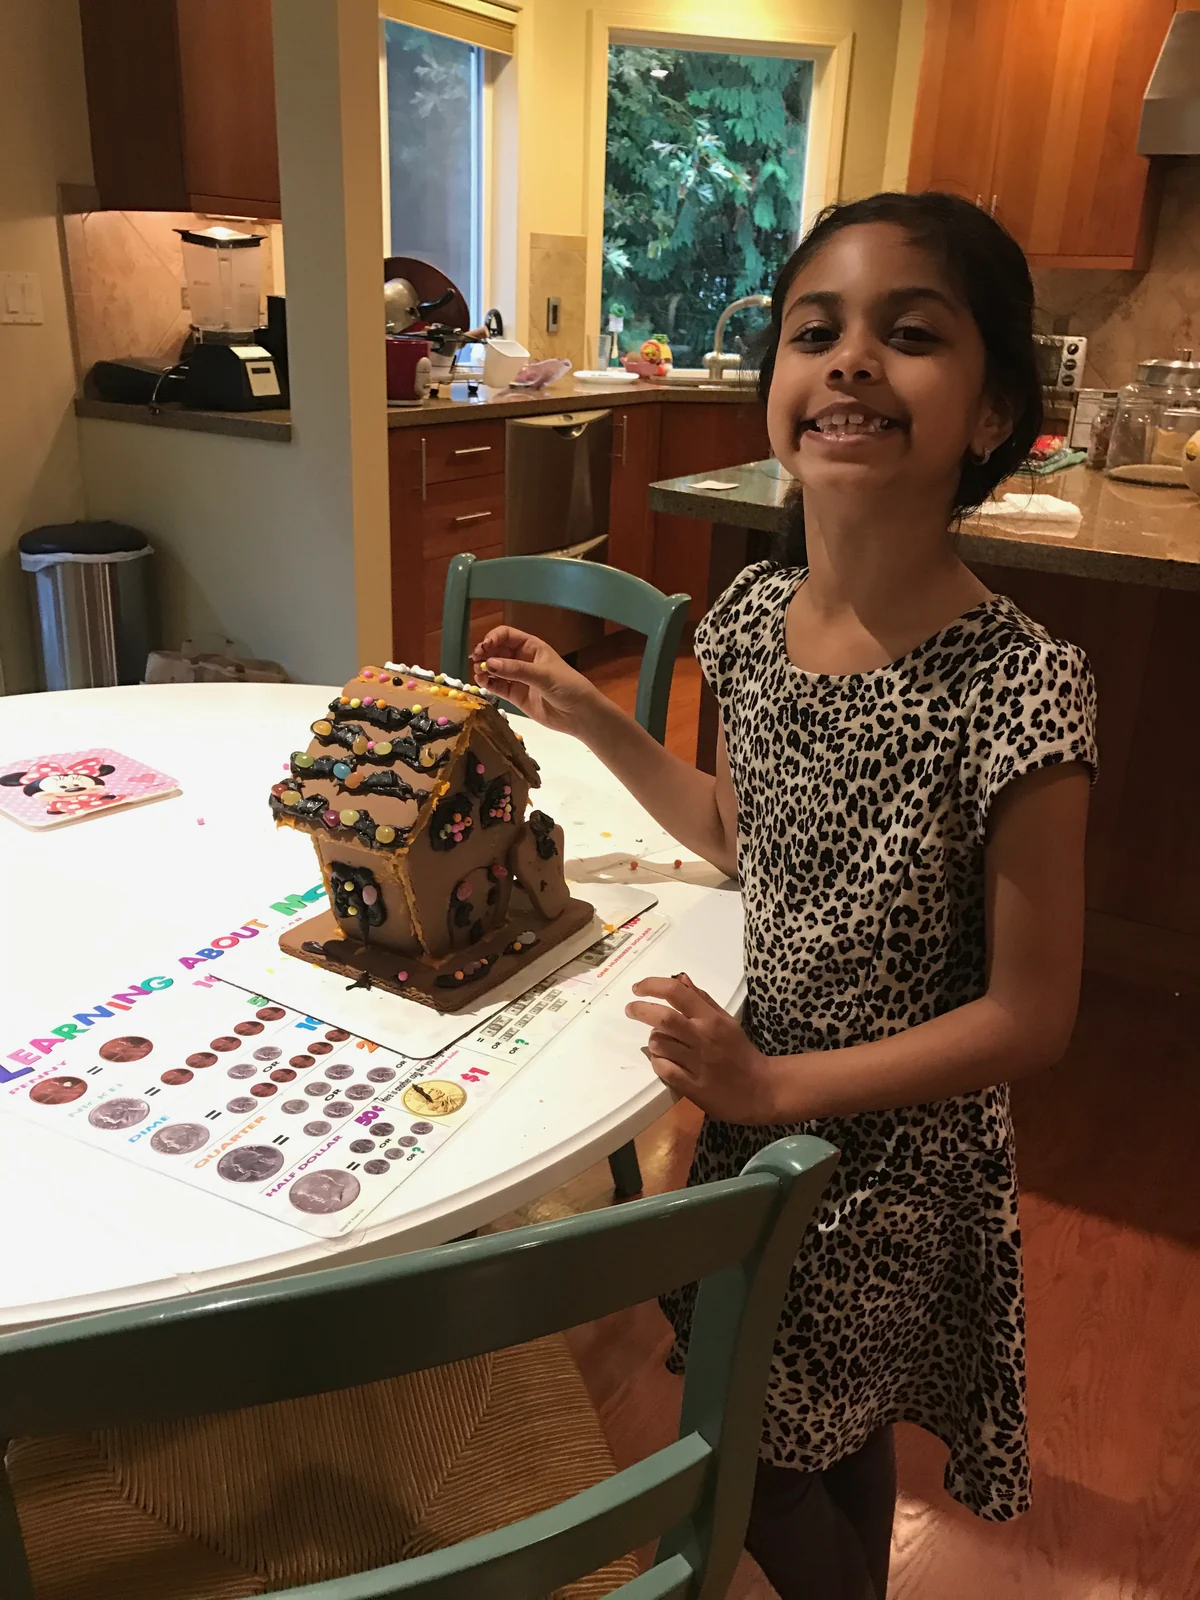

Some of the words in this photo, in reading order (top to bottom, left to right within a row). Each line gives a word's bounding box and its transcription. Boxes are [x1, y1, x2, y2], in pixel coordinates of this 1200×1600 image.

[0, 976, 174, 1083] LEARNING
[178, 918, 269, 970] ABOUT
[247, 995, 270, 1008] 5
[491, 1041, 502, 1050] OR
[508, 1046, 520, 1055] OR
[262, 1061, 280, 1073] OR
[395, 1060, 407, 1069] OR
[8, 1060, 67, 1095] PENNY
[460, 1067, 490, 1083] $1
[324, 1088, 342, 1101] OR
[128, 1115, 171, 1143] DIME
[193, 1115, 267, 1169] QUARTER
[379, 1138, 392, 1149] OR
[406, 1153, 417, 1162] OR
[265, 1172, 297, 1198] HALF
[298, 1135, 343, 1171] DOLLAR
